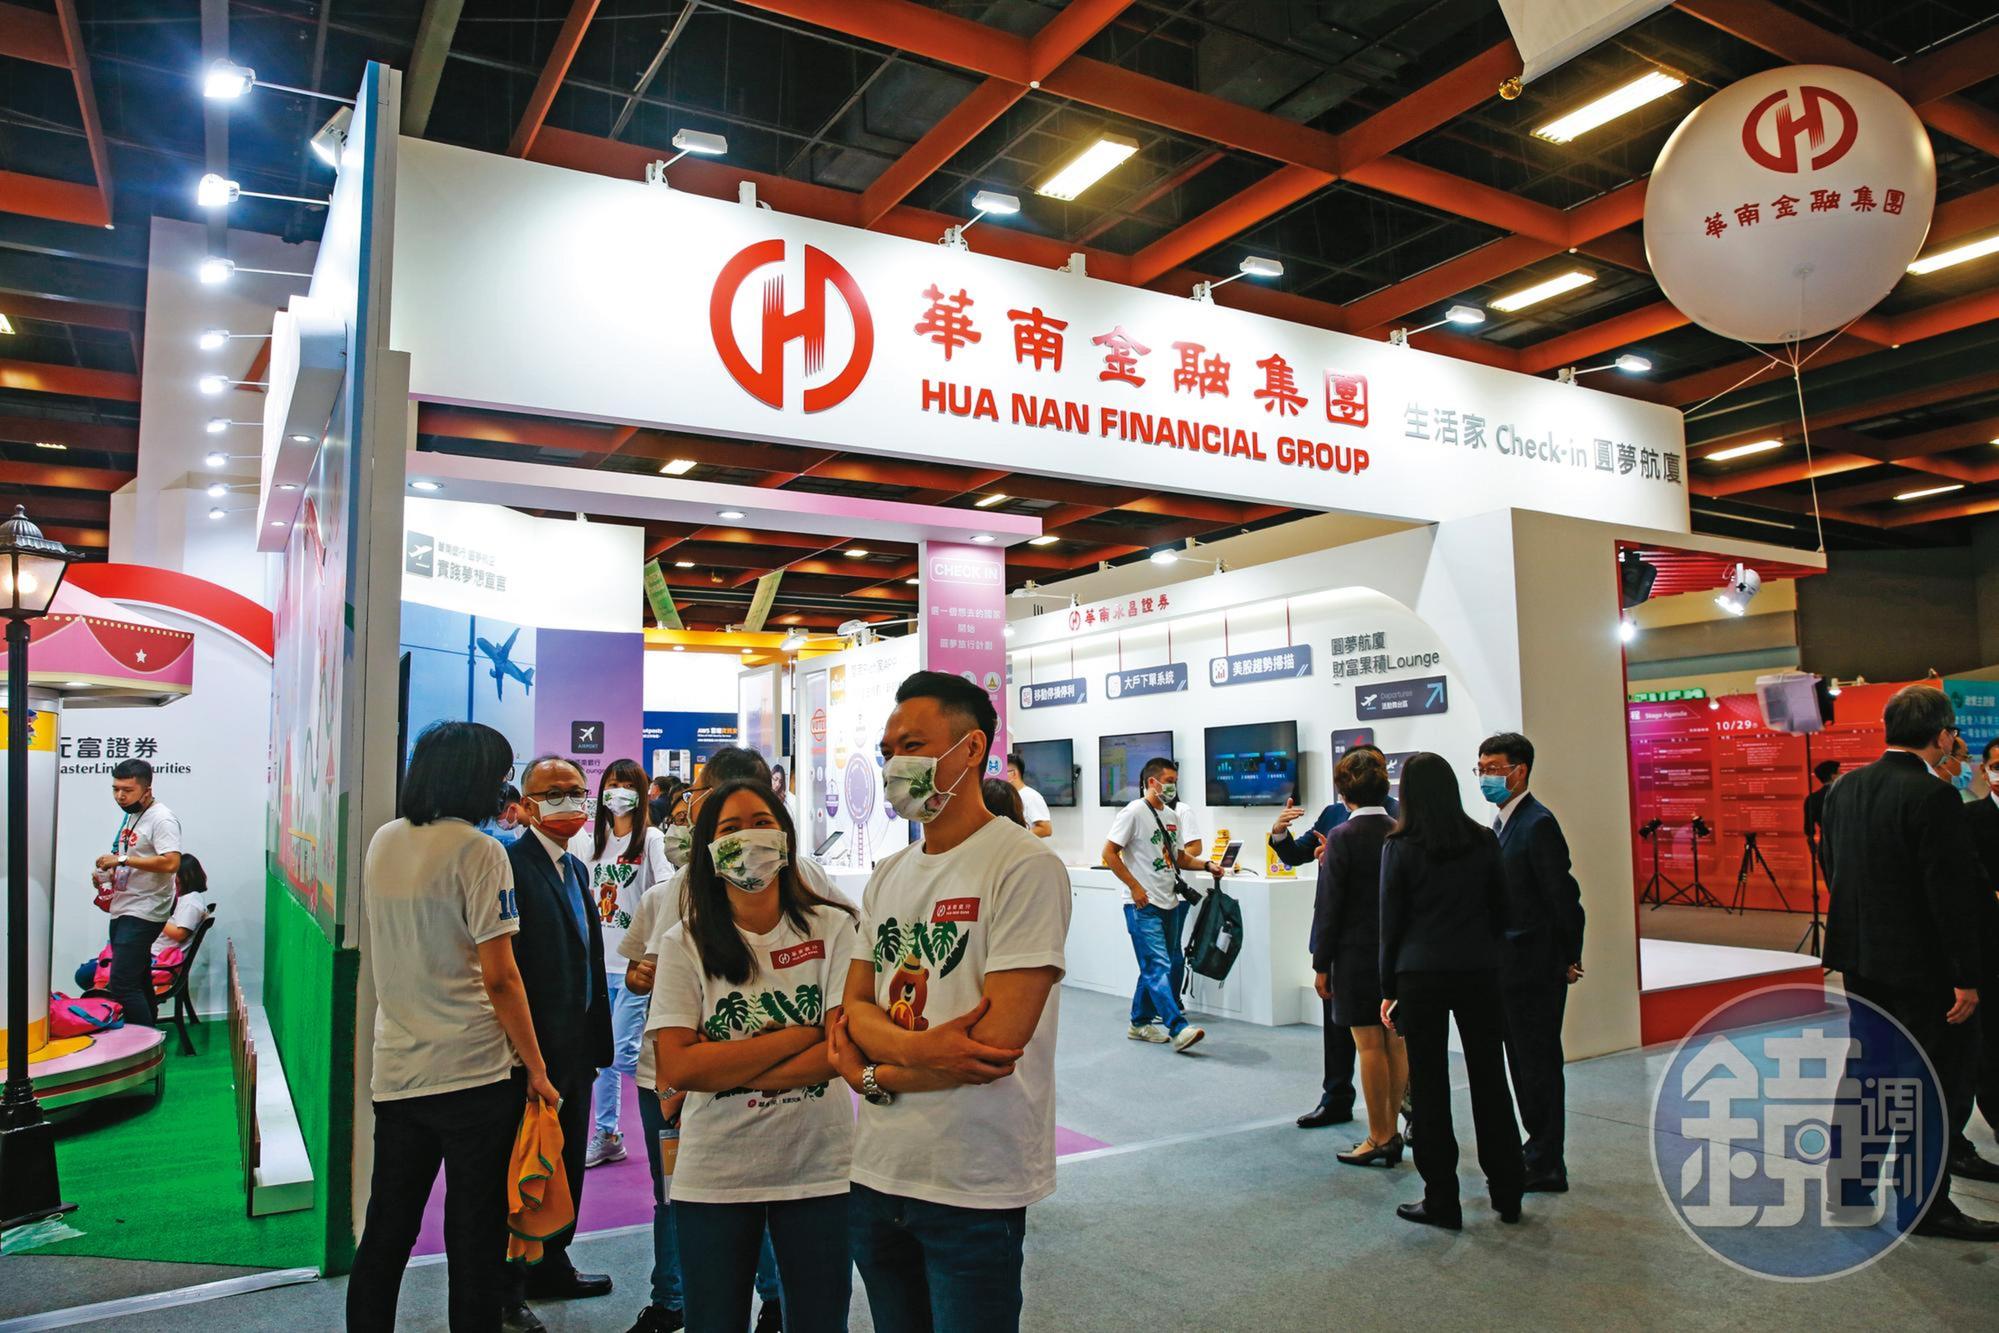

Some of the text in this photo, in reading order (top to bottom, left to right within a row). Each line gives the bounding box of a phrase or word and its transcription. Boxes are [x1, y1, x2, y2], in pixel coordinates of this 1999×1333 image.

[1704, 185, 1905, 238] 華南金融集團
[913, 283, 1370, 428] 華南金融集團
[922, 379, 1370, 475] HUA NAN FINANCIAL GROUP
[1403, 402, 1683, 485] 生活家 Check-in 圓夢航廈
[934, 564, 998, 580] CHECK IN
[1085, 594, 1169, 626] 華南永昌證券
[1331, 632, 1386, 656] 圓夢航廈
[1232, 653, 1295, 677] 美股趨勢掃描
[1124, 670, 1175, 690] 大戶下單系統
[1034, 684, 1075, 701] 移動停損停利
[1664, 710, 1688, 719] Agenda
[1716, 720, 1752, 731] 10/29
[60, 737, 158, 758] 元富證券
[60, 762, 117, 774] asterLin
